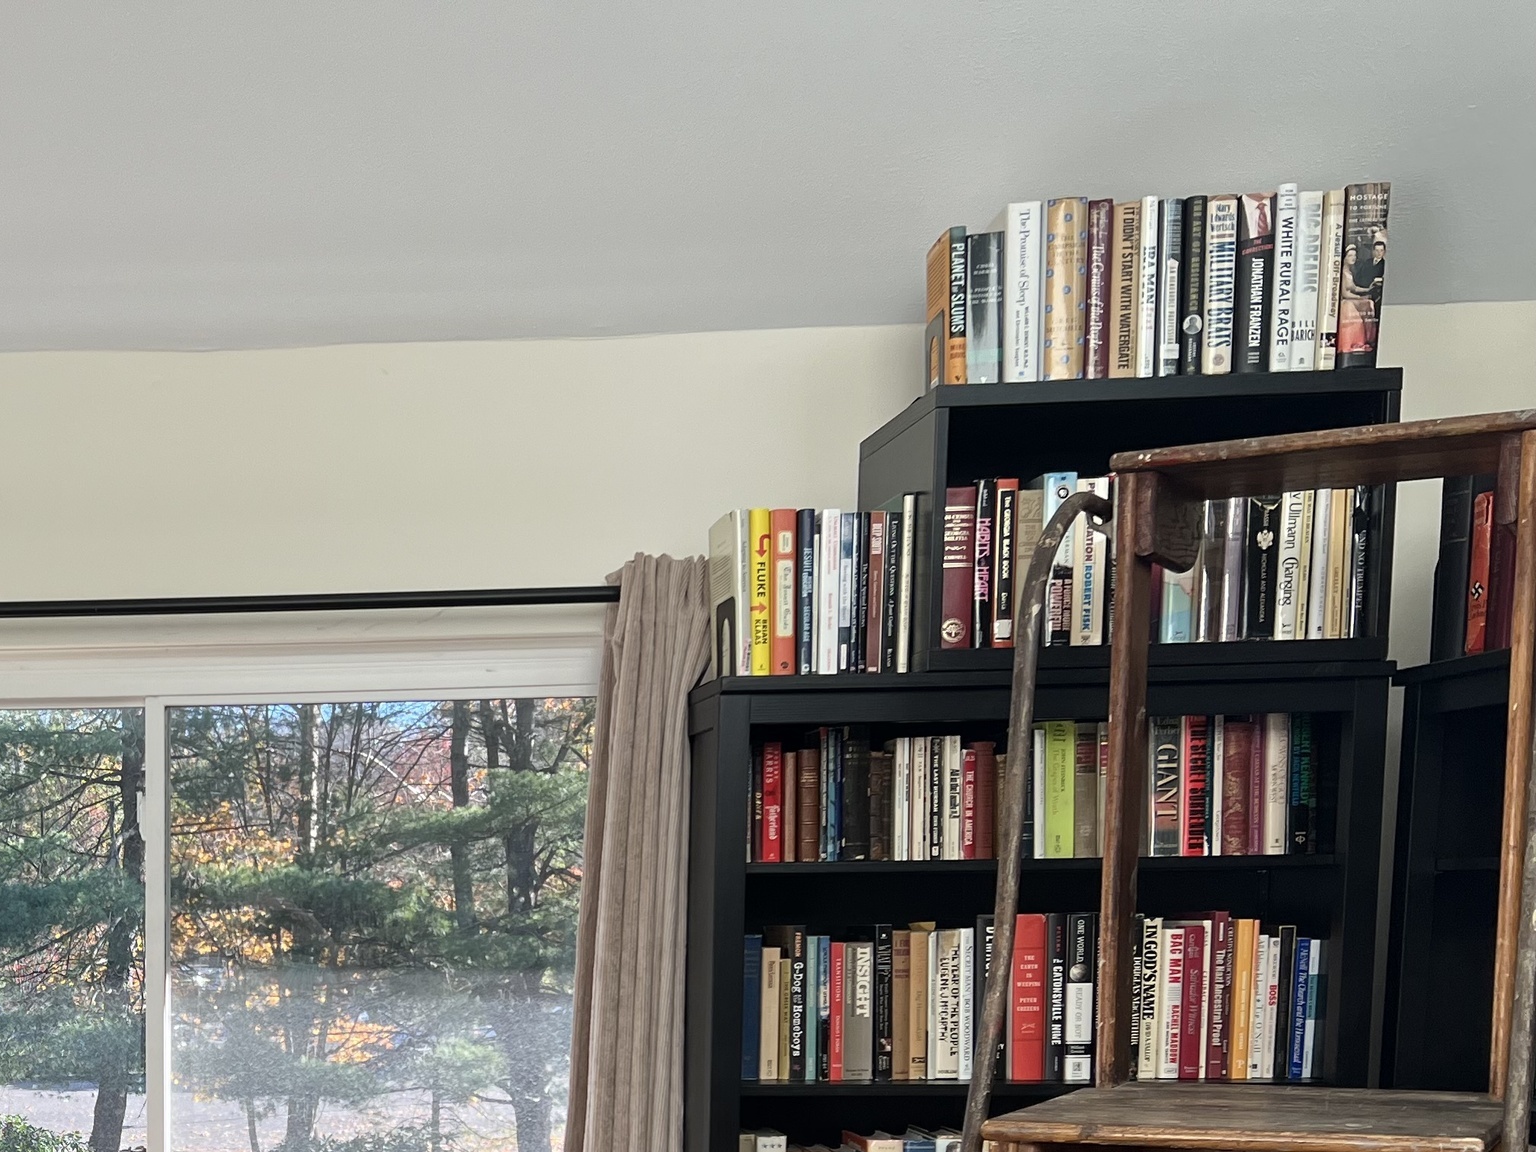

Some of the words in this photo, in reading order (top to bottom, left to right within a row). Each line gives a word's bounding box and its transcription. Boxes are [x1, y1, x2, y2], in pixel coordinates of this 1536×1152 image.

[1019, 209, 1030, 229] The
[1123, 207, 1135, 215] IT
[1018, 230, 1029, 266] Promise
[1122, 218, 1134, 251] DIDN'T
[1280, 217, 1294, 257] WHITE
[951, 243, 965, 287] PLANET
[1091, 243, 1105, 260] The
[1019, 267, 1029, 279] of
[1090, 261, 1104, 295] Genius
[1120, 253, 1133, 282] START
[1207, 241, 1235, 304] MILITARY
[1250, 257, 1264, 303] JONATHAN
[1278, 261, 1291, 304] RURAL
[1014, 281, 1029, 306] Sleep
[1088, 297, 1104, 309] of
[1119, 285, 1132, 311] WITH
[1328, 260, 1340, 318] Off-Broadway
[951, 294, 965, 333] SLUMS
[1091, 308, 1102, 320] the
[1207, 308, 1233, 348] BRATS
[1248, 304, 1261, 347] FRANZEN
[1276, 309, 1290, 346] RAGE
[1087, 321, 1102, 350] People
[1117, 314, 1131, 369] WATERGATE
[1291, 329, 1315, 342] BARICH
[976, 518, 991, 557] HABITS
[1285, 502, 1300, 550] Ullmann
[803, 547, 813, 572] JESUIT
[756, 562, 766, 598] FLUKE
[975, 566, 988, 602] HEART
[1084, 565, 1093, 606] ROBERT
[1278, 557, 1298, 606] Changing
[754, 619, 762, 645] KLAAS
[1082, 608, 1091, 630] FISK
[1191, 723, 1204, 743] THE
[765, 747, 773, 783] HARRIS
[966, 770, 974, 781] THE
[1190, 746, 1204, 784] SECRET
[965, 784, 973, 808] CHURCH
[1157, 744, 1178, 821] GIANT
[767, 805, 780, 839] Fatherland
[964, 818, 973, 845] AMERICA
[1188, 787, 1204, 849] SURRENDER
[1145, 925, 1157, 939] IN
[1171, 934, 1182, 954] BAG
[951, 944, 959, 964] THE
[964, 946, 972, 974] SECRET
[1144, 940, 1157, 982] GOD'S
[1215, 950, 1225, 964] The
[791, 962, 804, 993] G-Dog
[856, 948, 870, 1017] INSIGHT
[951, 966, 959, 984] YEAR
[1169, 958, 1182, 983] MAN
[1215, 966, 1223, 982] Nazi
[951, 988, 958, 1001] OF
[1052, 966, 1063, 1020] CATONSVILLE
[1143, 984, 1155, 1020] NAME
[1213, 984, 1223, 1022] Ancestral
[1269, 985, 1278, 1006] BOSS
[791, 1005, 803, 1056] Homeboys
[1075, 1012, 1081, 1022] OR
[1171, 1005, 1179, 1030] RACHEL
[950, 1021, 958, 1056] PEOPLE
[1051, 1024, 1061, 1045] NINE
[1170, 1033, 1179, 1063] MADDOW
[1212, 1024, 1222, 1045] Proof
